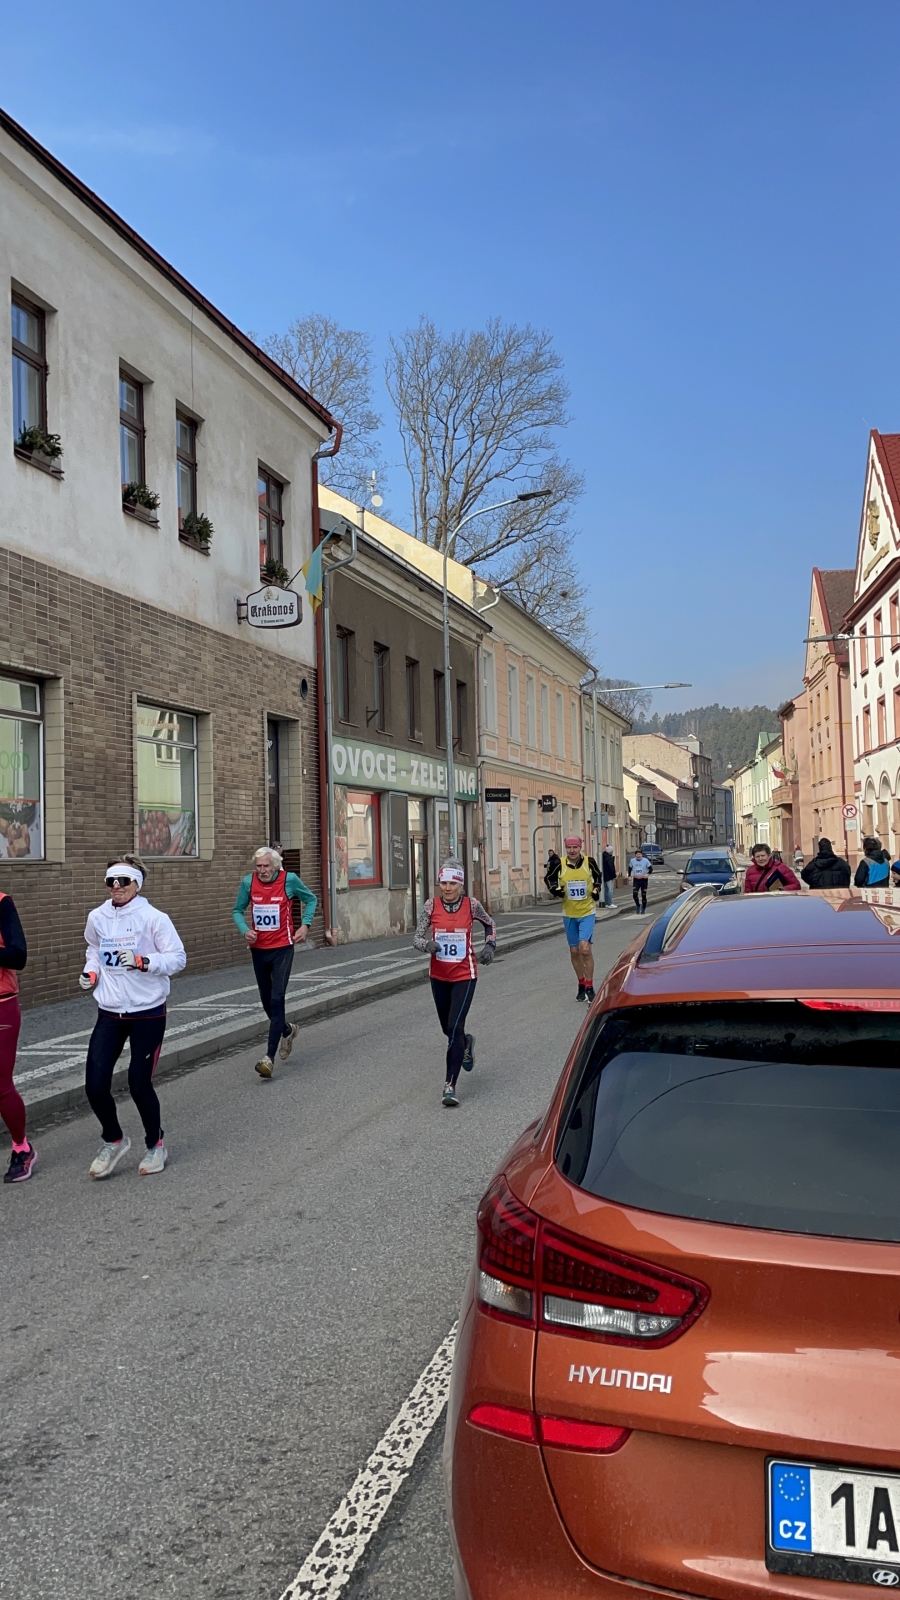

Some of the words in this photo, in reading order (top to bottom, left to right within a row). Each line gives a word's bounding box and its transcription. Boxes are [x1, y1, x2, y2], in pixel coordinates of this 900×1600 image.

[250, 602, 294, 618] Krakonoš
[332, 744, 397, 783] OVOCE
[570, 888, 586, 897] 318
[256, 915, 277, 926] 201
[443, 944, 458, 956] 18
[568, 1364, 672, 1394] HYUNDAI
[831, 1482, 900, 1553] 1A
[779, 1519, 806, 1541] CZ
